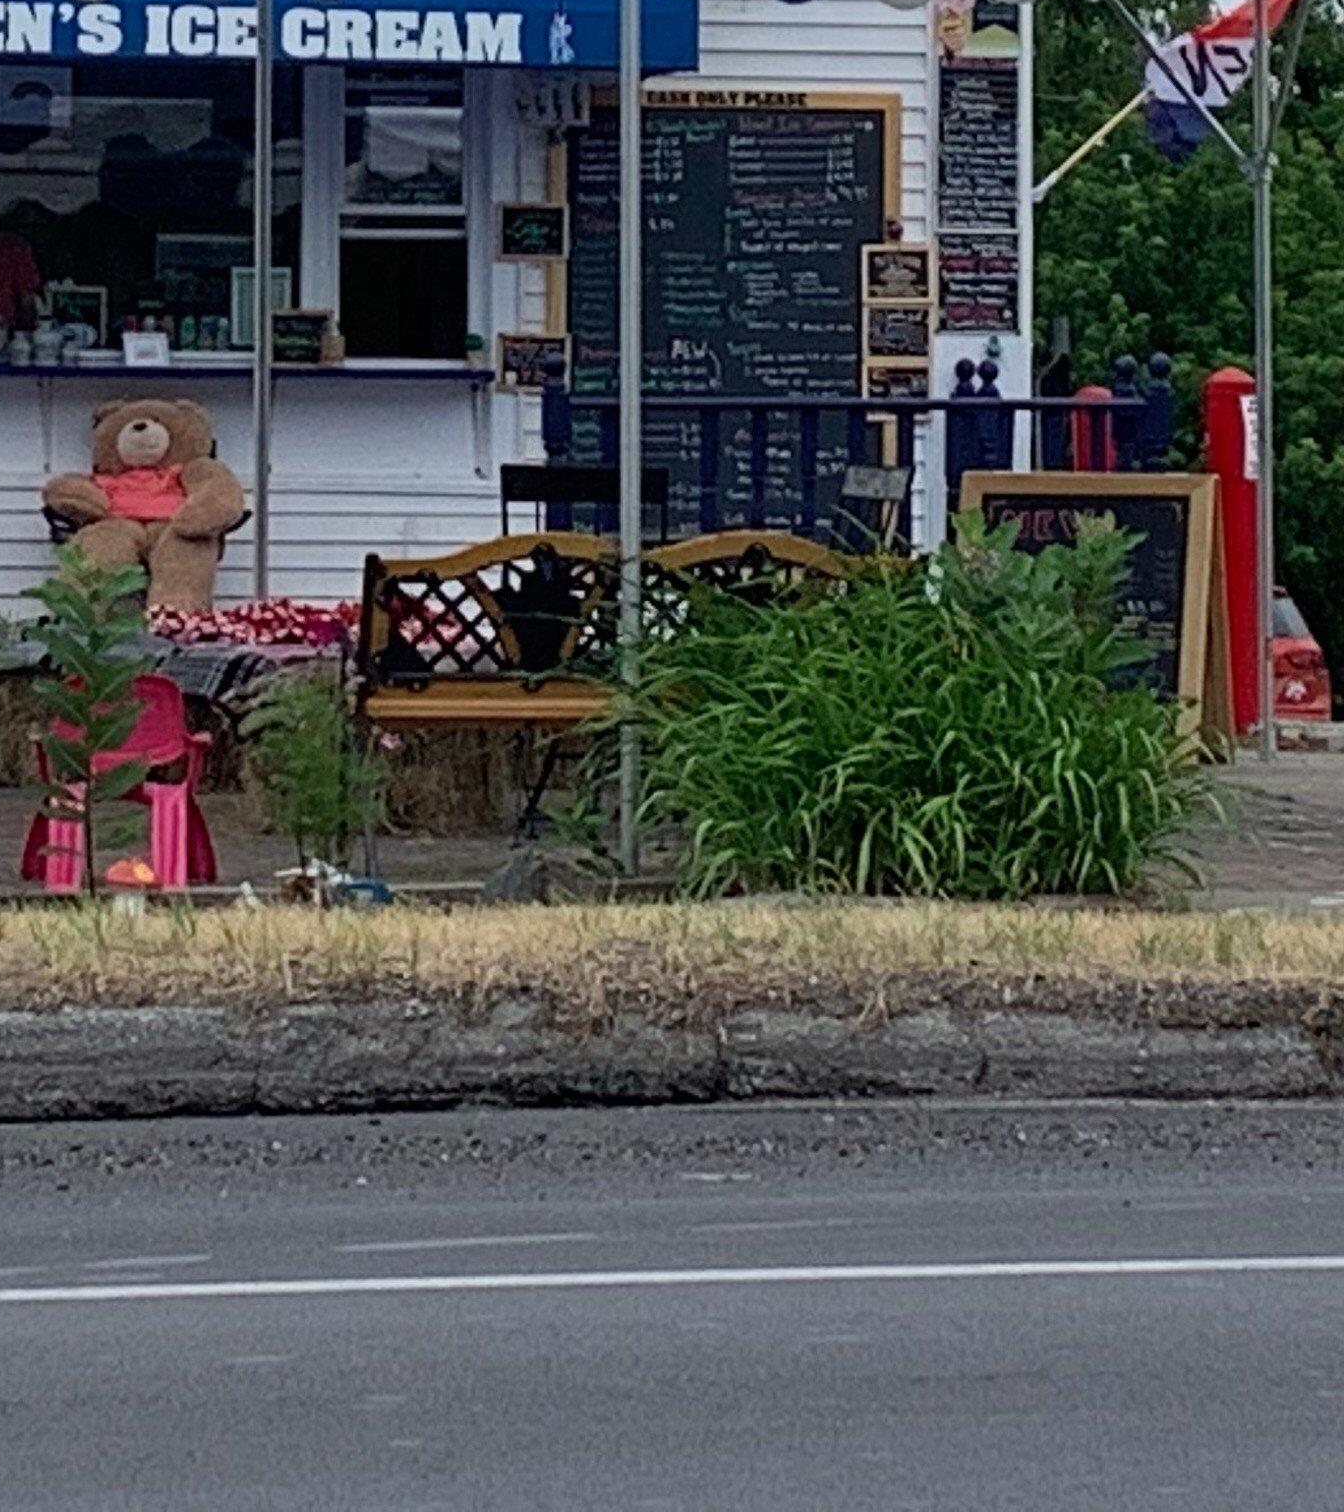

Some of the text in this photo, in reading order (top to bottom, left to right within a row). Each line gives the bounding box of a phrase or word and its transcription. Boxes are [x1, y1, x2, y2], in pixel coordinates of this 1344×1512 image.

[145, 4, 257, 56] ICE
[281, 8, 523, 62] CREAM
[647, 91, 807, 105] CASH ONLY PLEASE
